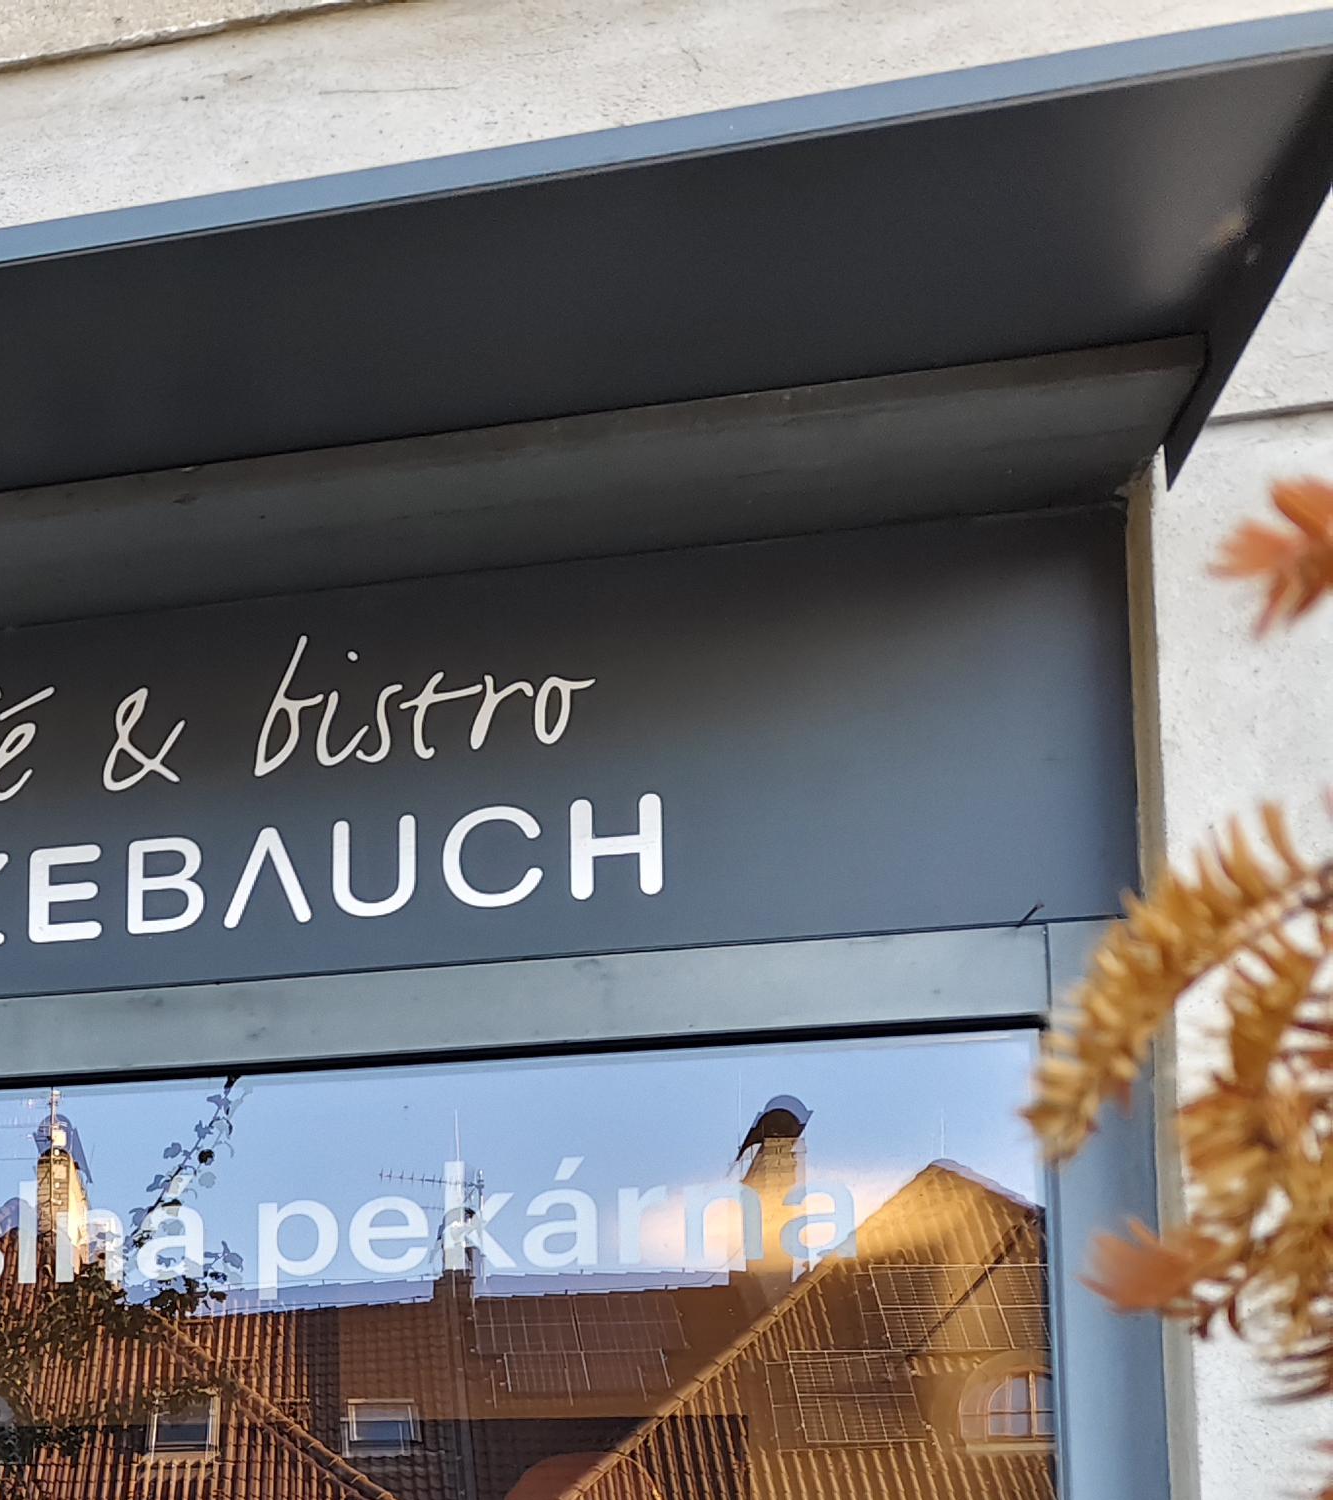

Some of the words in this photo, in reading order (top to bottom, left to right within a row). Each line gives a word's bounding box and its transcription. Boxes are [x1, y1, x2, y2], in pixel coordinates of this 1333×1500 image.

[103, 687, 185, 790] &
[254, 635, 595, 776] bistro
[257, 1156, 858, 1300] pekárna
